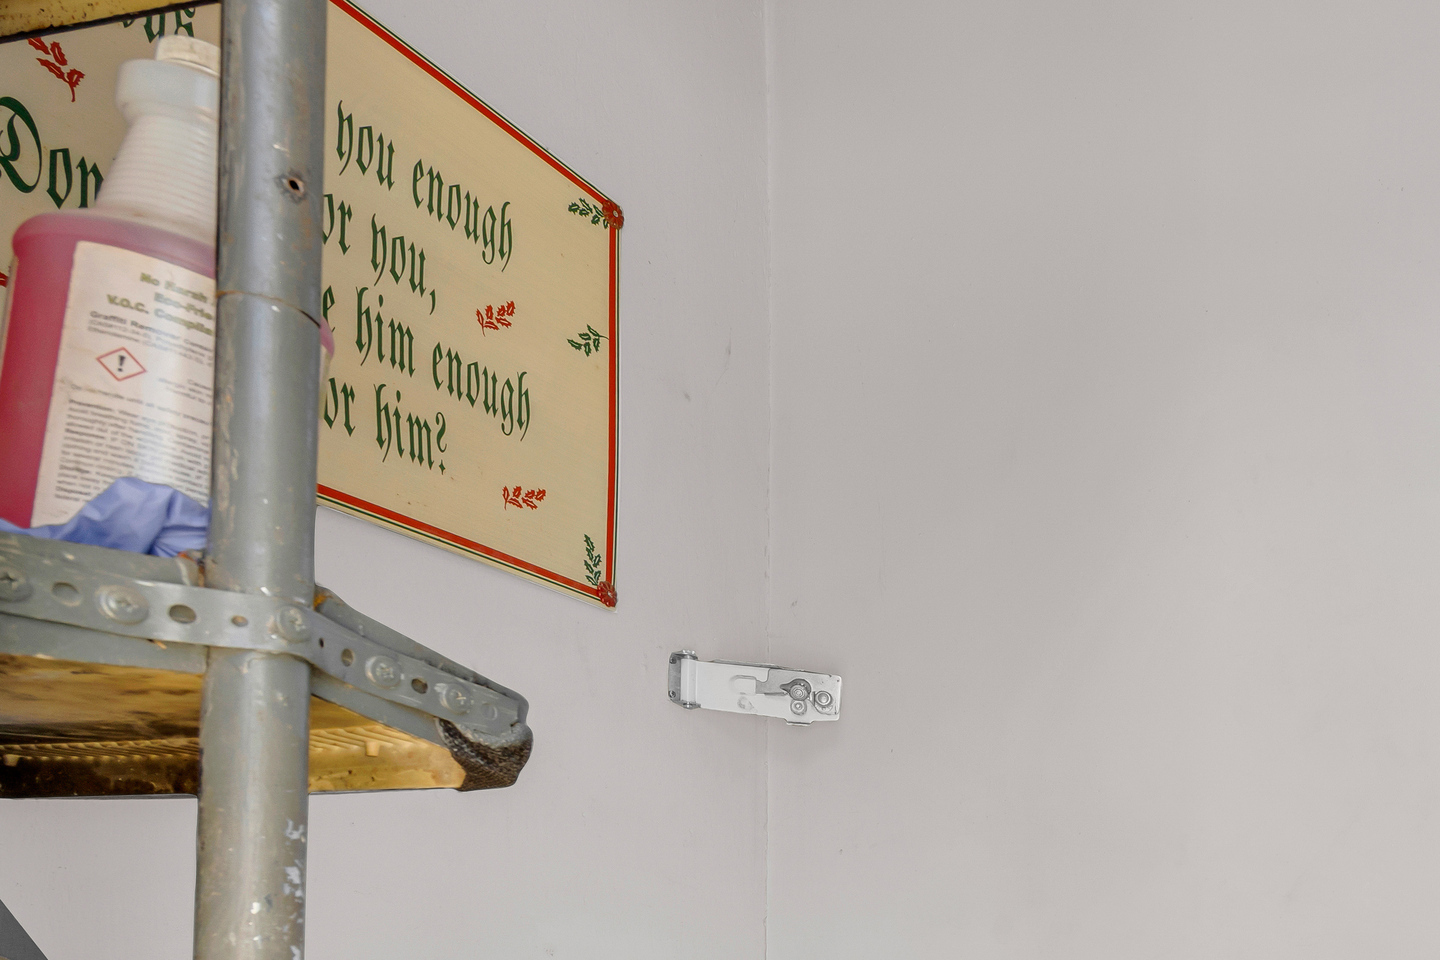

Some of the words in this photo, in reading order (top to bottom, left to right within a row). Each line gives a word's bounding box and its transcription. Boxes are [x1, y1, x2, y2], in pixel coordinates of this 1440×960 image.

[321, 193, 353, 256] or
[370, 212, 437, 316] you,
[336, 99, 395, 192] you
[411, 158, 513, 273] enough
[322, 376, 356, 437] or
[373, 383, 447, 475] him?
[355, 286, 416, 378] him
[431, 341, 531, 442] enough
